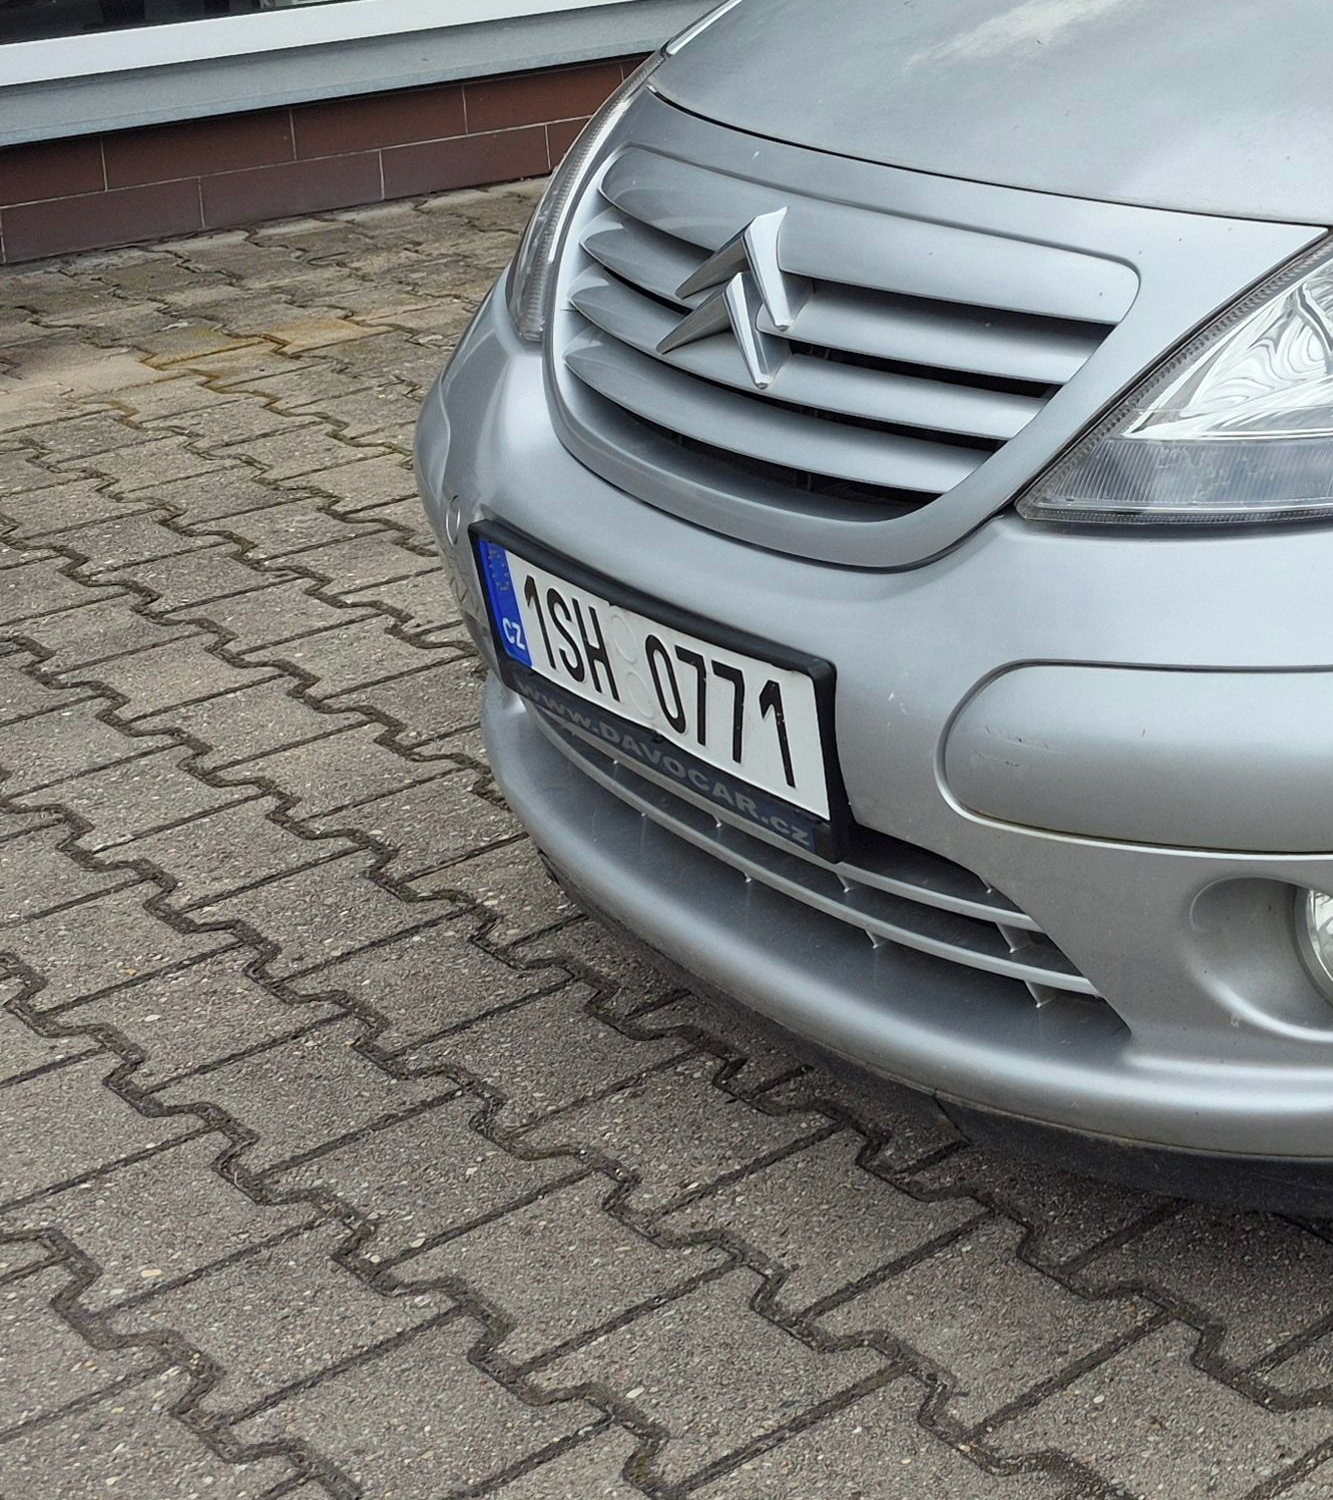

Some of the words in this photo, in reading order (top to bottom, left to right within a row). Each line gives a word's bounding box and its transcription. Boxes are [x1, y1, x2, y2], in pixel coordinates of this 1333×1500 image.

[502, 617, 527, 652] CZ
[523, 574, 620, 702] 1SH
[645, 634, 798, 790] 0771
